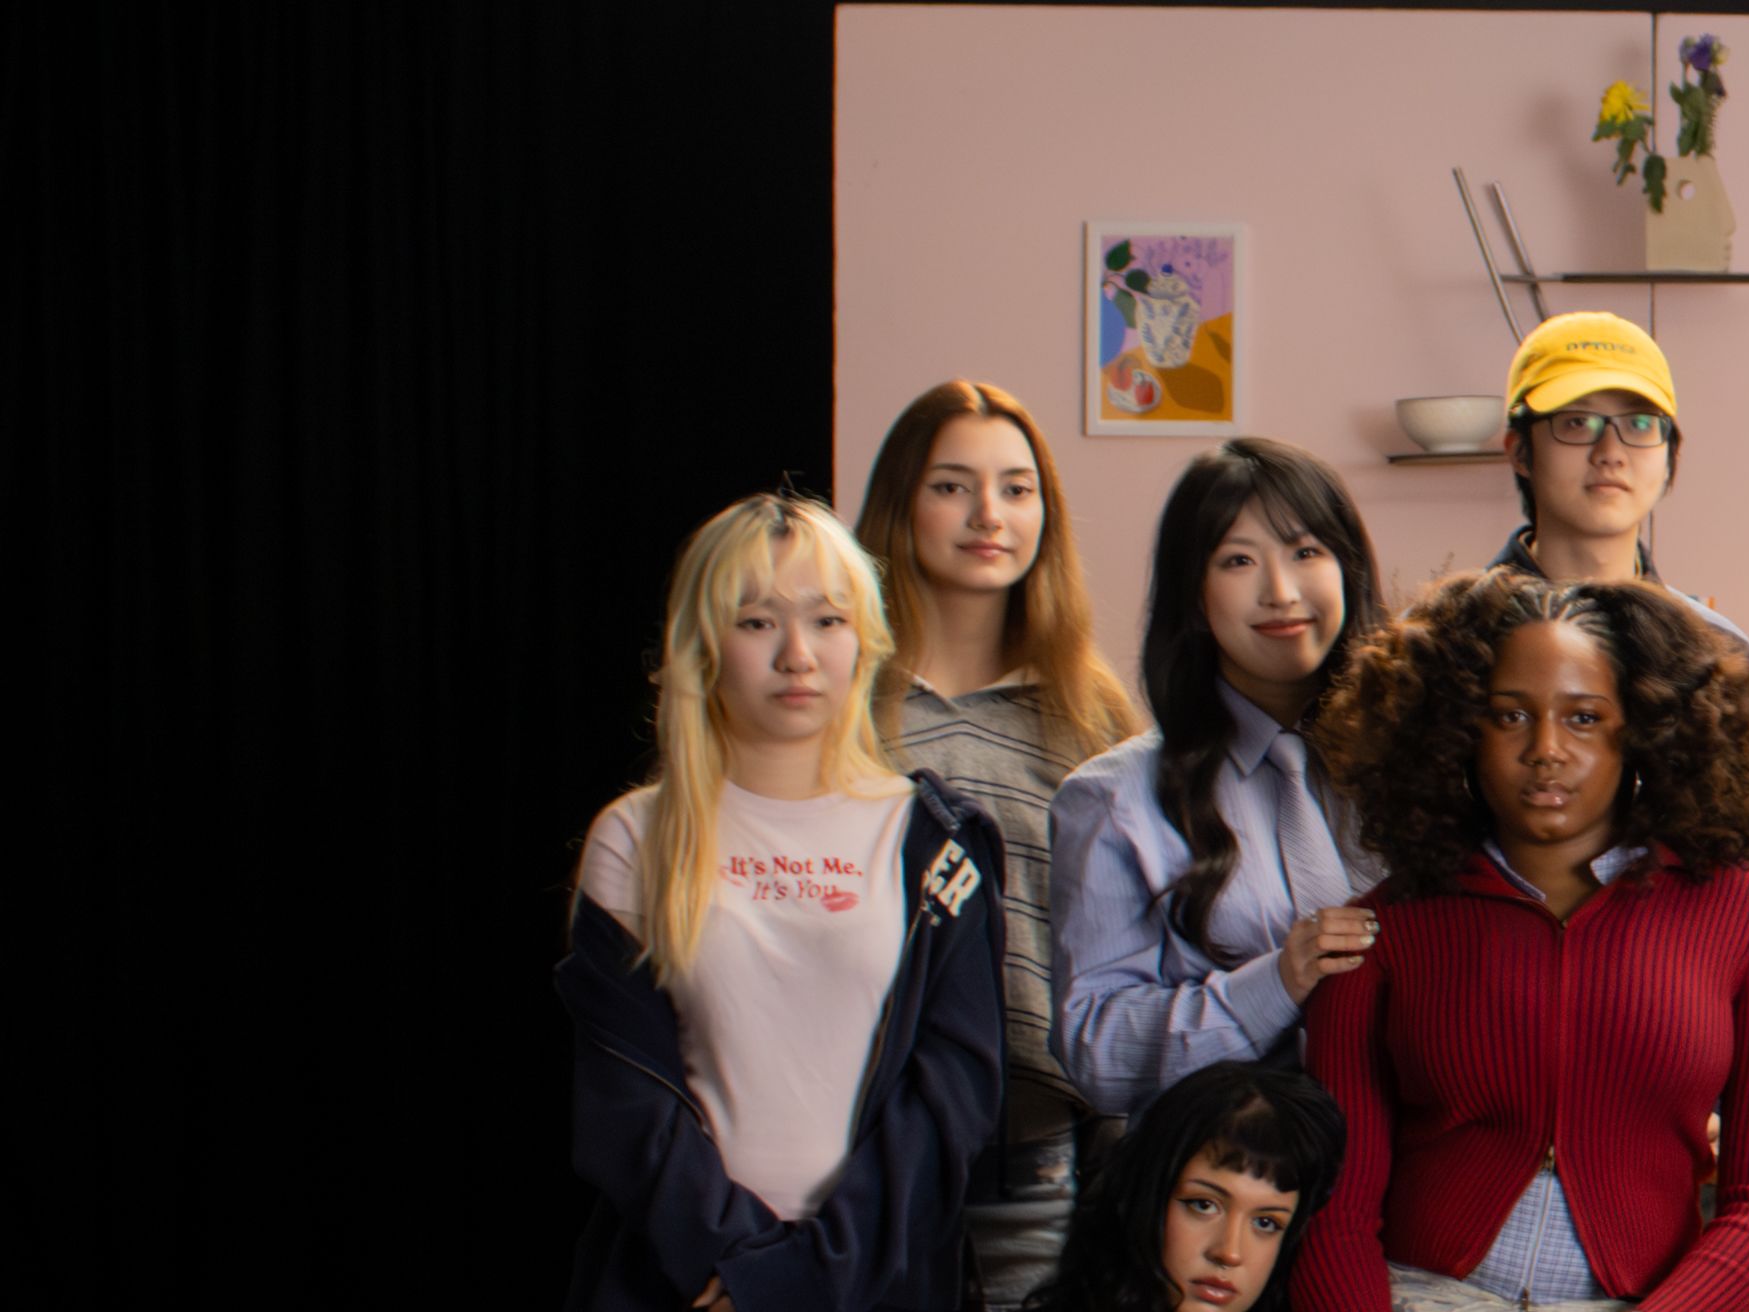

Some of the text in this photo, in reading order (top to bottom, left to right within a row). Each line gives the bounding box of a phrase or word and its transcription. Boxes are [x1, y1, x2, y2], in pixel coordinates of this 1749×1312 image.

[730, 856, 768, 878] It's
[772, 855, 816, 876] Not
[752, 880, 788, 901] It's
